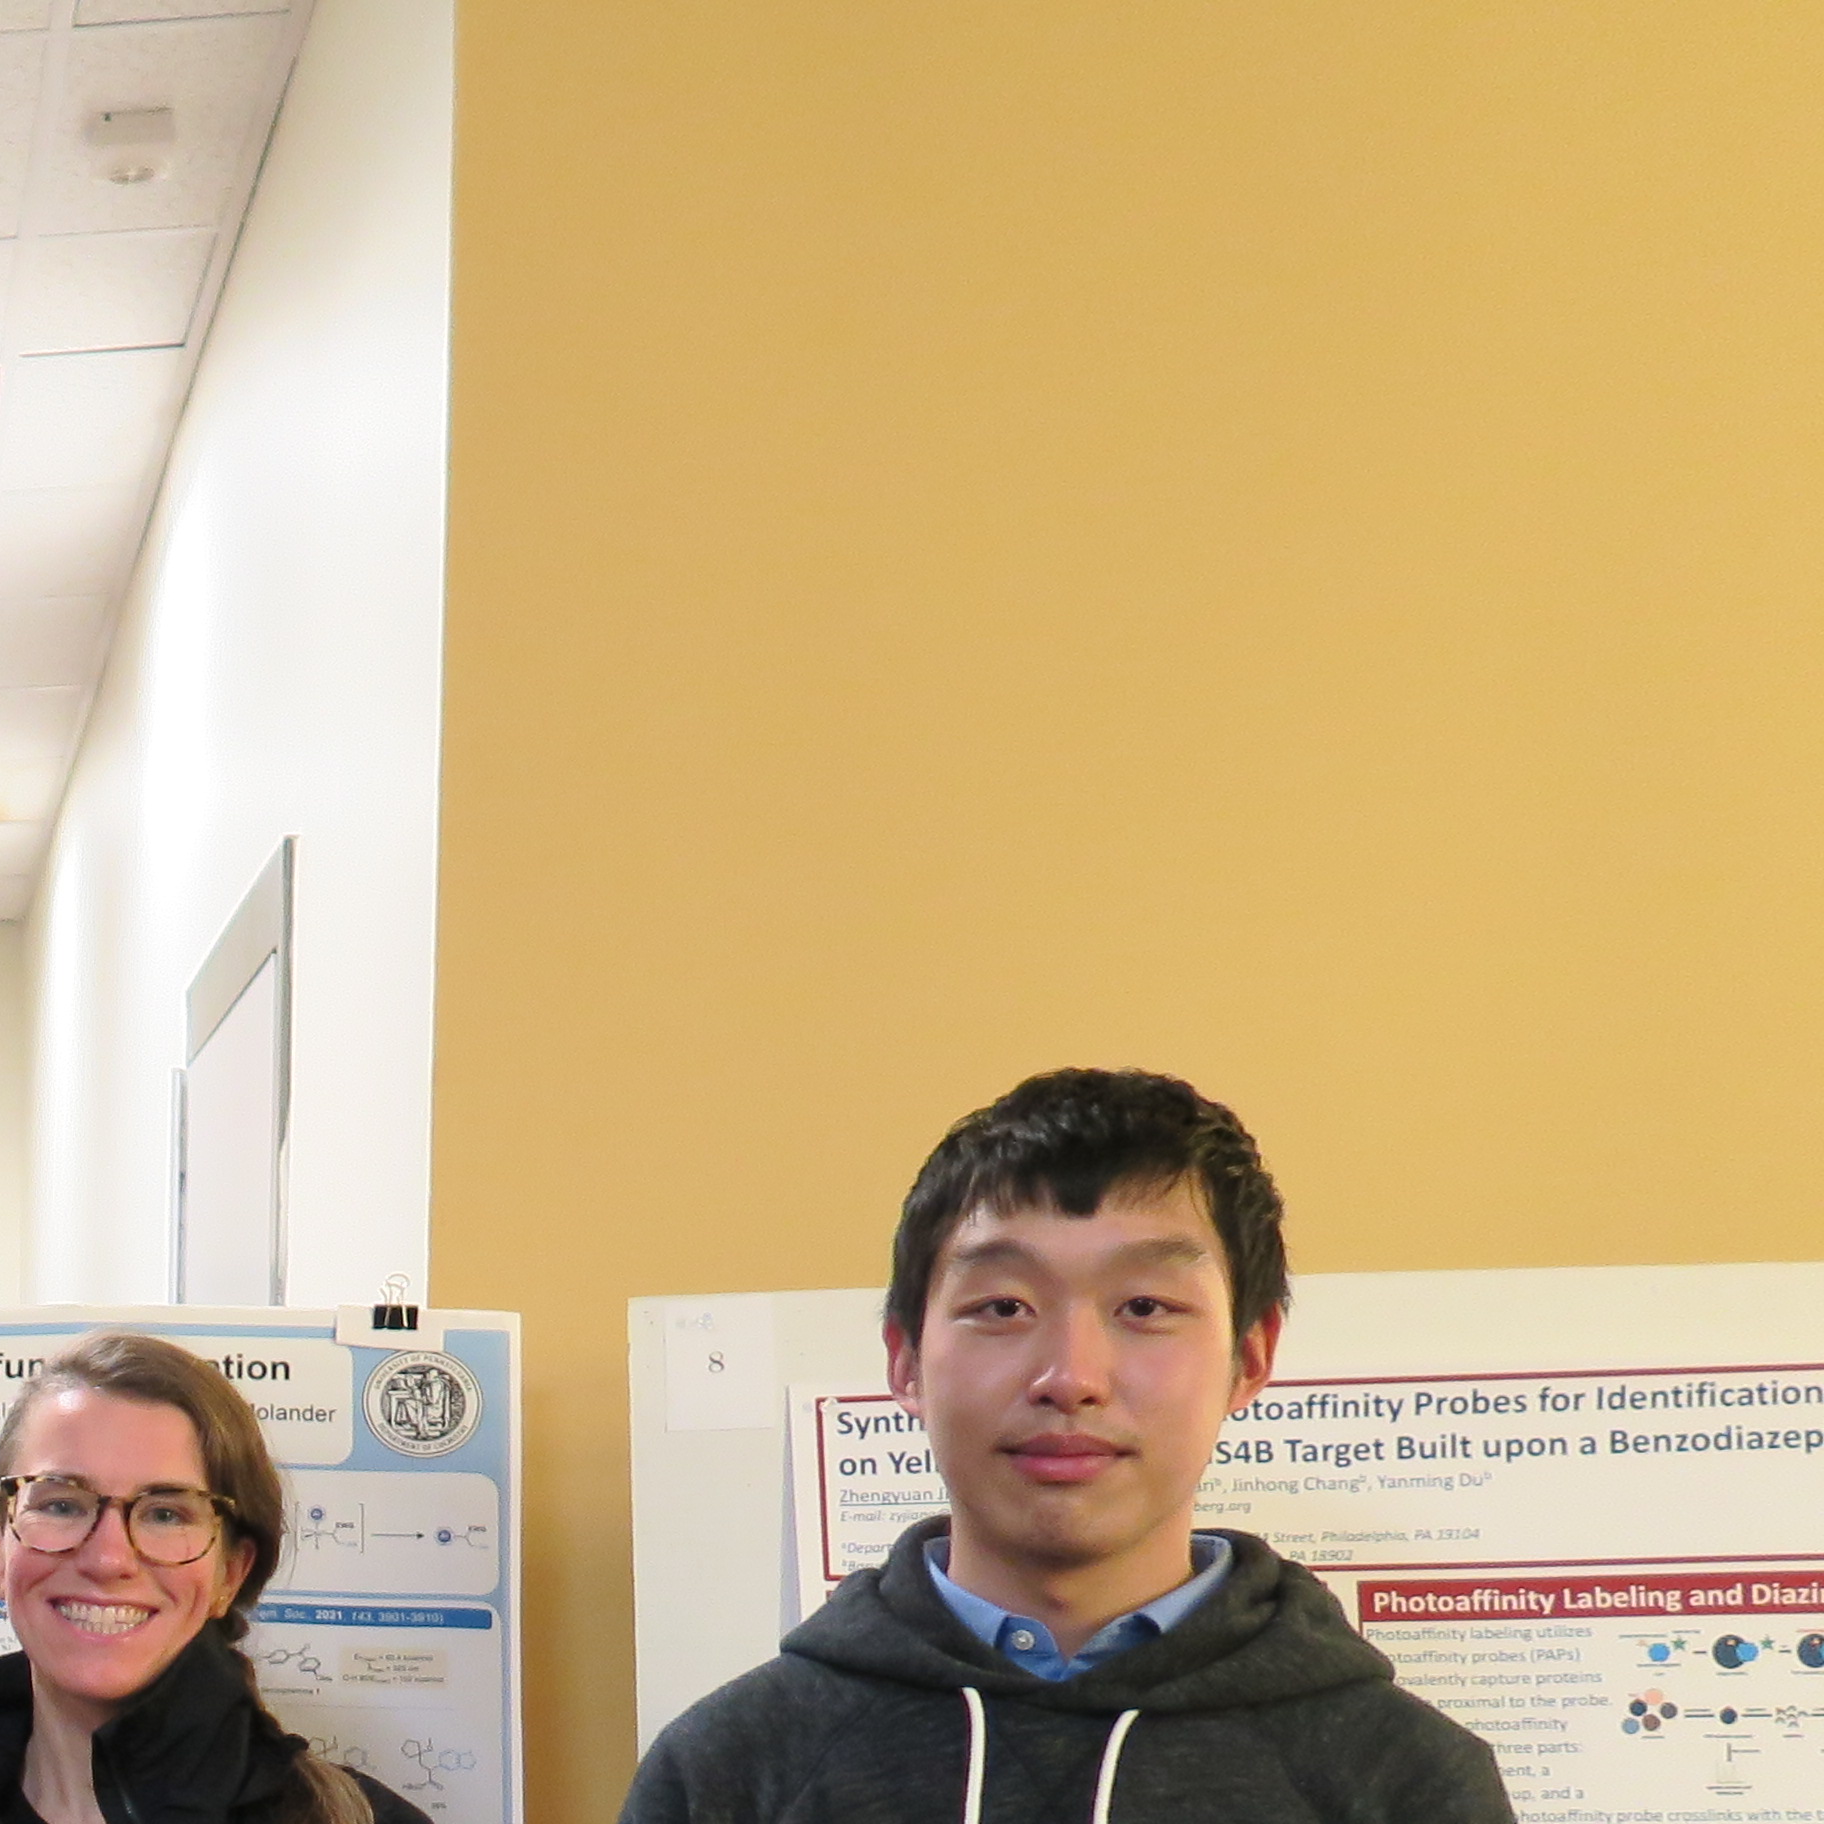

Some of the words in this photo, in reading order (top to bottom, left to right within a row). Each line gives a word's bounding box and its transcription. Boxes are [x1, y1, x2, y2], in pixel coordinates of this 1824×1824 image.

[708, 1351, 725, 1374] 8
[1224, 1392, 1403, 1423] otoaffinity
[1414, 1389, 1527, 1417] Probes
[1539, 1386, 1585, 1412] for
[1597, 1380, 1824, 1411] Identification
[253, 1404, 338, 1424] olander
[839, 1457, 877, 1476] on
[1211, 1439, 1274, 1465] S4B
[1284, 1438, 1385, 1468] Target
[1397, 1433, 1471, 1460] Built
[1484, 1437, 1568, 1463] upon
[1579, 1436, 1597, 1455] a
[1609, 1425, 1824, 1455] Benzodiazep
[840, 1488, 932, 1507] Zhengyuan
[1232, 1477, 1299, 1496] Jinhong
[1377, 1473, 1453, 1492] Yanming
[840, 1511, 885, 1523] E-mail:
[1273, 1530, 1317, 1544] Street,
[1320, 1528, 1409, 1544] Philadelphia,
[1414, 1530, 1433, 1541] PA
[1289, 1550, 1307, 1561] PA
[1373, 1586, 1555, 1615] Photoaffinity
[1563, 1584, 1683, 1613] Labeling
[1689, 1582, 1744, 1607] and
[1367, 1626, 1466, 1642] Photoaffinity
[1470, 1626, 1532, 1642] labeling
[1536, 1624, 1592, 1639] utilizes
[1472, 1650, 1526, 1665] probes
[1530, 1648, 1581, 1663] (PAPs)
[1471, 1672, 1531, 1687] capture
[1536, 1670, 1602, 1686] proteins
[1437, 1694, 1505, 1709] proximal
[1509, 1696, 1525, 1708] to
[1530, 1694, 1558, 1708] the
[1561, 1693, 1612, 1709] probe.
[1464, 1717, 1568, 1733] photoaffinity
[1537, 1741, 1582, 1757] parts:
[1617, 1809, 1663, 1824] probe
[1668, 1808, 1741, 1823] crosslinks
[1747, 1808, 1782, 1822] with
[1786, 1808, 1814, 1822] the
